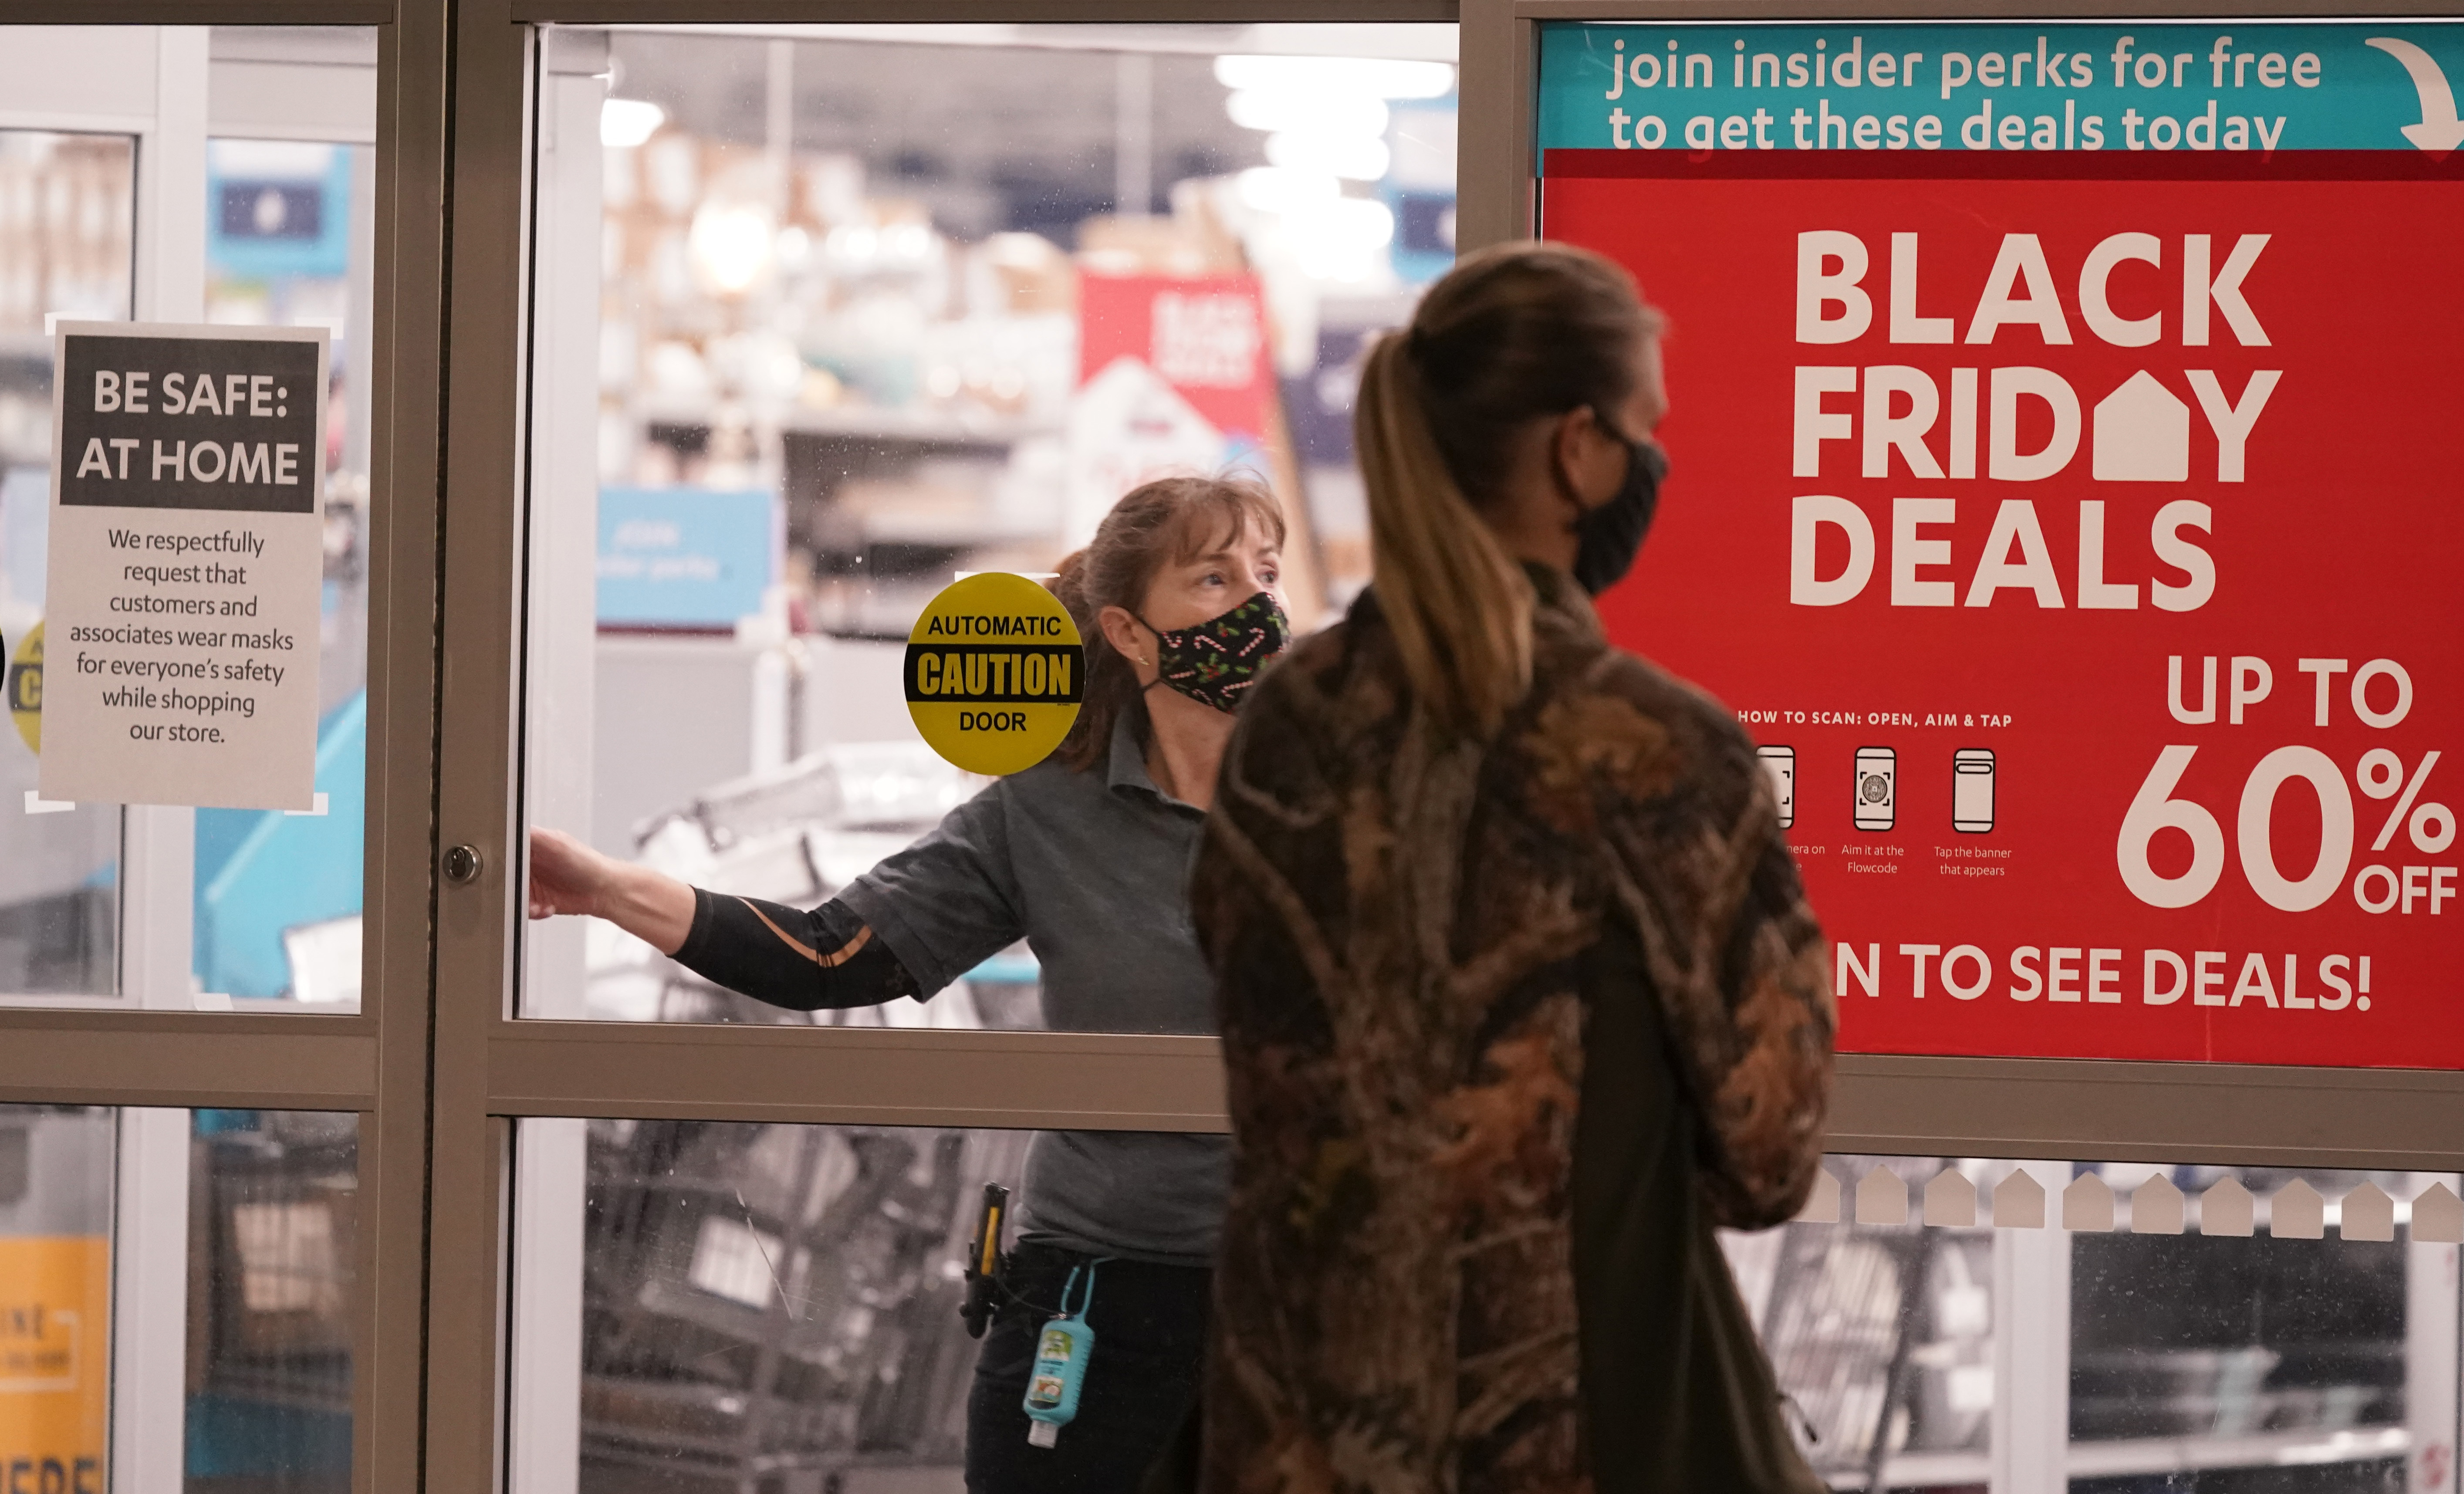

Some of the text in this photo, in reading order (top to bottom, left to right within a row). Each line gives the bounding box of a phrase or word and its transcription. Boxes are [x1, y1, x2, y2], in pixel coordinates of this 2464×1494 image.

[1606, 37, 2320, 100] join insider perks for free
[1609, 98, 2286, 162] to get these deals today
[1796, 230, 2271, 347] BLACK
[95, 371, 287, 417] BE SAFE:
[76, 438, 298, 484] AT HOME
[109, 530, 264, 558] We respectfully
[1791, 495, 2215, 612] DEALS
[125, 563, 246, 586] request that
[110, 595, 257, 616] customers and
[71, 624, 293, 650] associates wear masks
[928, 616, 1061, 635] AUTOMATIC
[77, 653, 284, 686] for everyone’s safety
[918, 653, 1070, 695] CAUTION
[103, 686, 254, 717] while shopping
[2168, 656, 2413, 728] UP TO
[130, 724, 224, 743] our store.
[960, 712, 1026, 731] DOOR
[1738, 711, 2011, 727] HOW TO SCAN: OPEN, AIM & TAP
[2117, 745, 2457, 914] 60%
[1842, 845, 1903, 855] Aim it at the
[1935, 846, 2011, 859] Tap the banner
[1848, 862, 1897, 873] Flowcode
[1940, 863, 2004, 877] that appears
[2354, 865, 2457, 914] OFF
[1900, 944, 1991, 1000] TO
[2011, 946, 2121, 1003] SEE
[2144, 950, 2370, 1011] DEALS!
